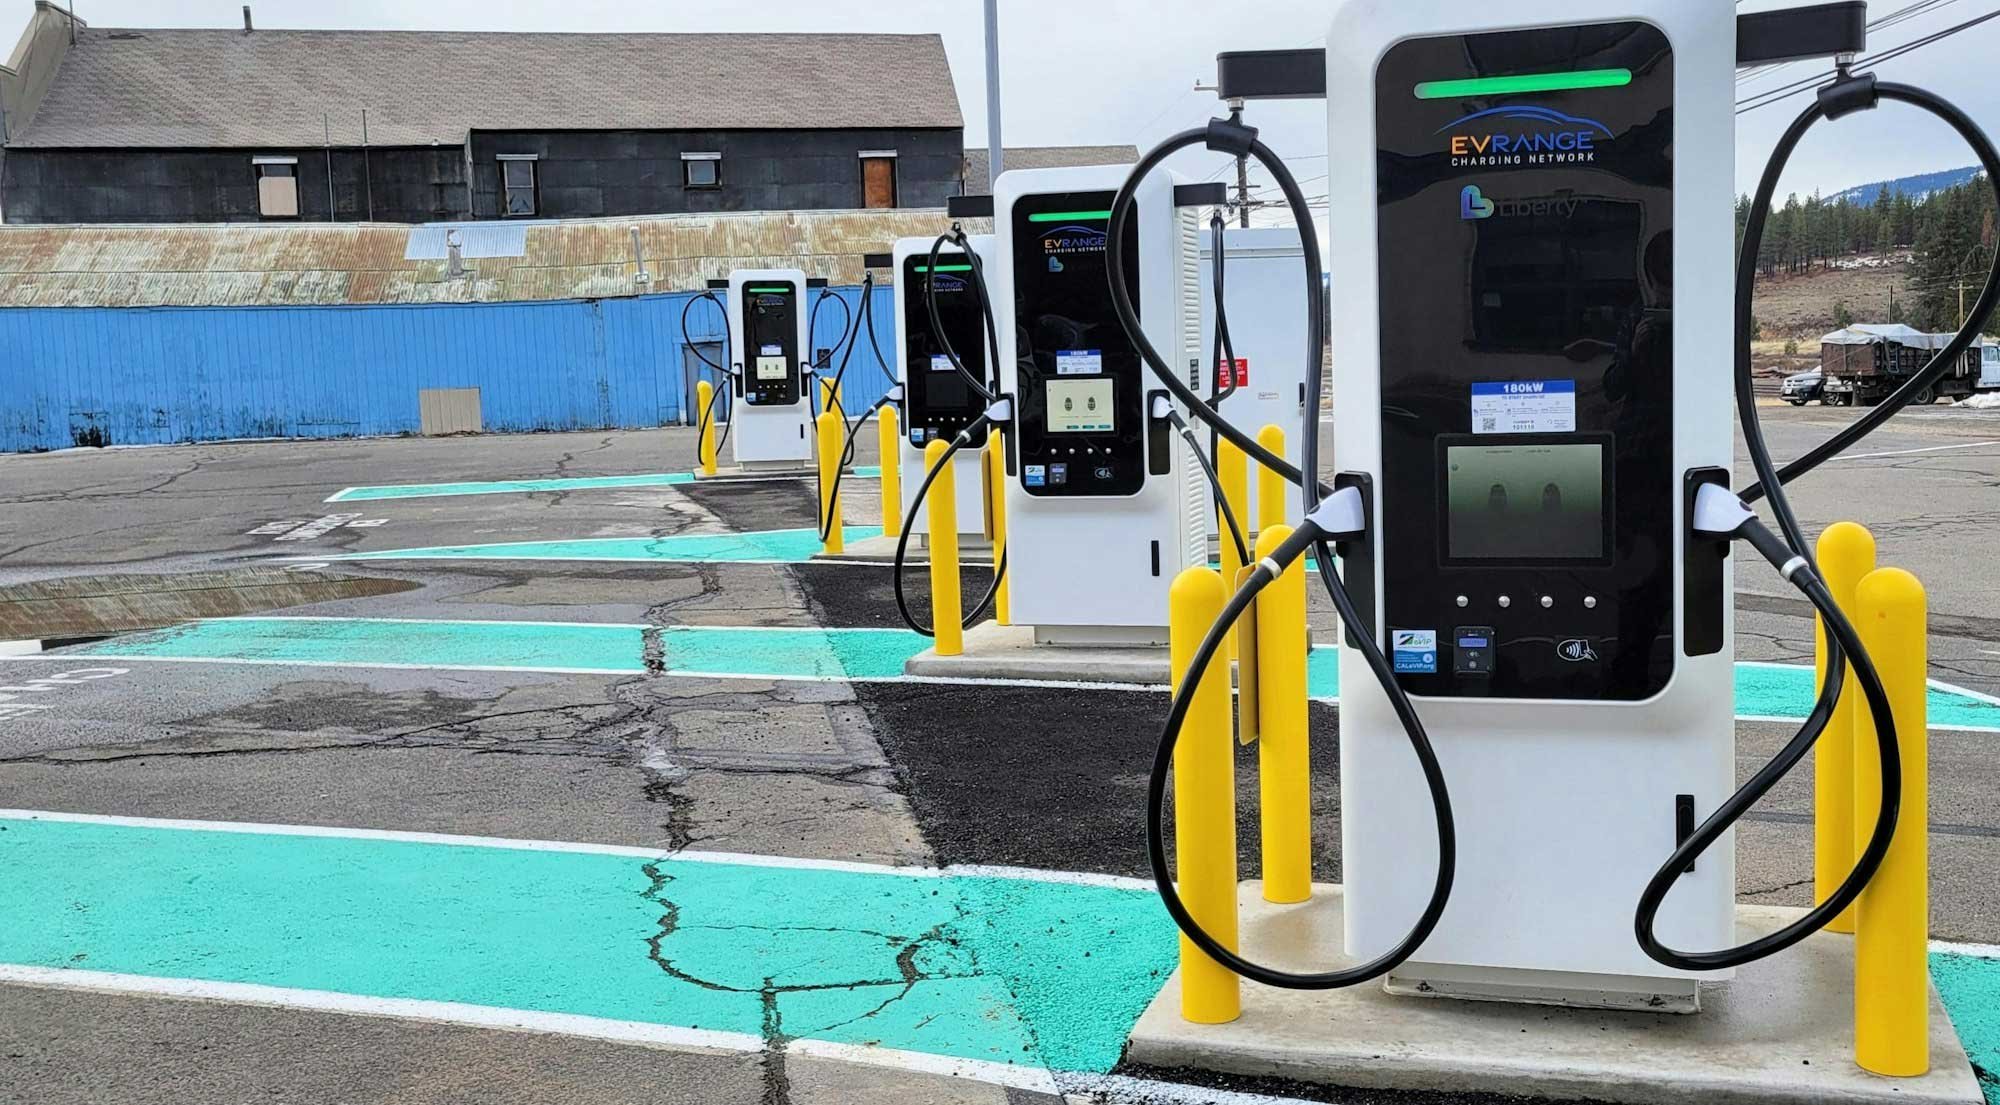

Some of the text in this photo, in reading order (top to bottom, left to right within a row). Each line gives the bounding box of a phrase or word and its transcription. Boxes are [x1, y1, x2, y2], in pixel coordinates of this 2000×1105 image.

[1451, 130, 1594, 155] EVRANGE
[1451, 151, 1595, 167] CHARGING NETWORK
[1499, 198, 1577, 218] Liberty
[1044, 237, 1105, 249] EVRANGE
[1503, 383, 1543, 393] 180kW
